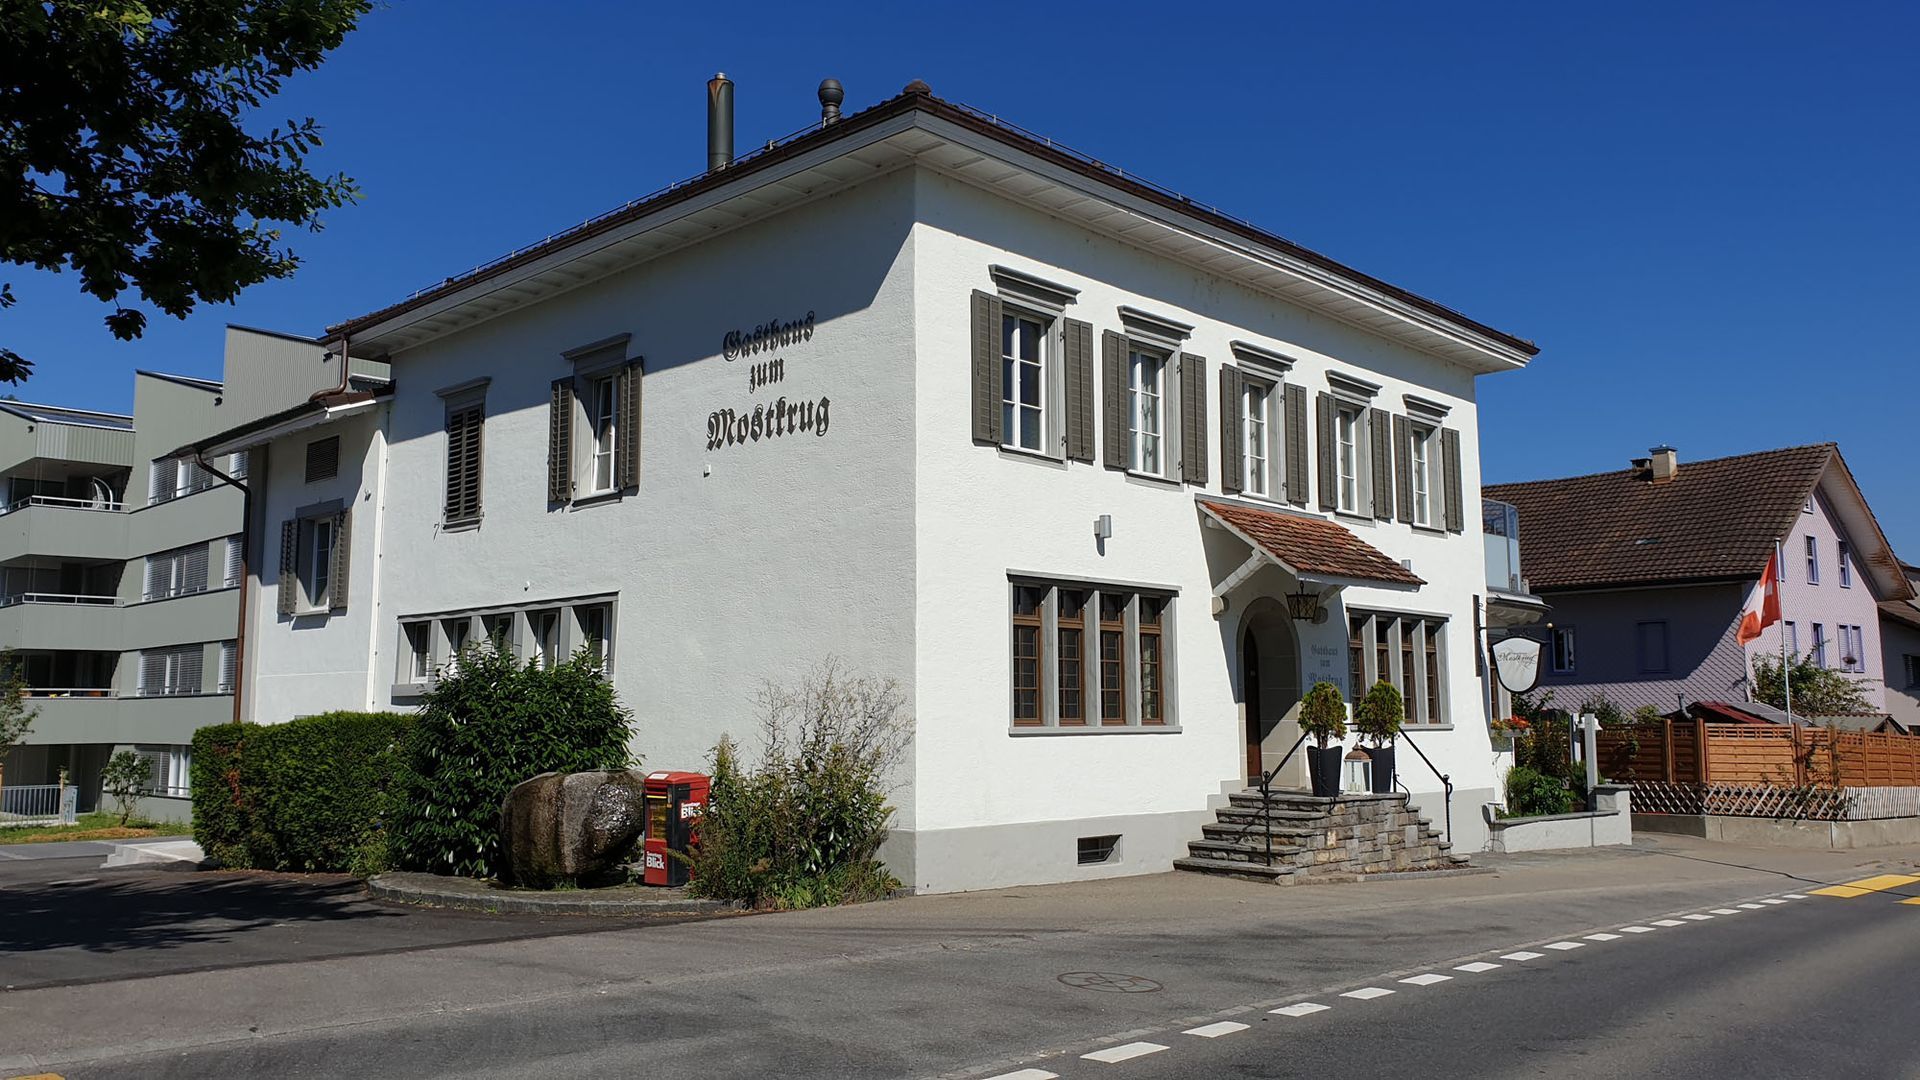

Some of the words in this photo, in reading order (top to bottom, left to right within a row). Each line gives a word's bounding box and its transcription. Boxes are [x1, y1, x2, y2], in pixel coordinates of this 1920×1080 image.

[722, 310, 815, 362] Gasthaus
[749, 357, 785, 394] zum
[706, 395, 831, 451] Mostkrug
[646, 856, 665, 870] Blick
